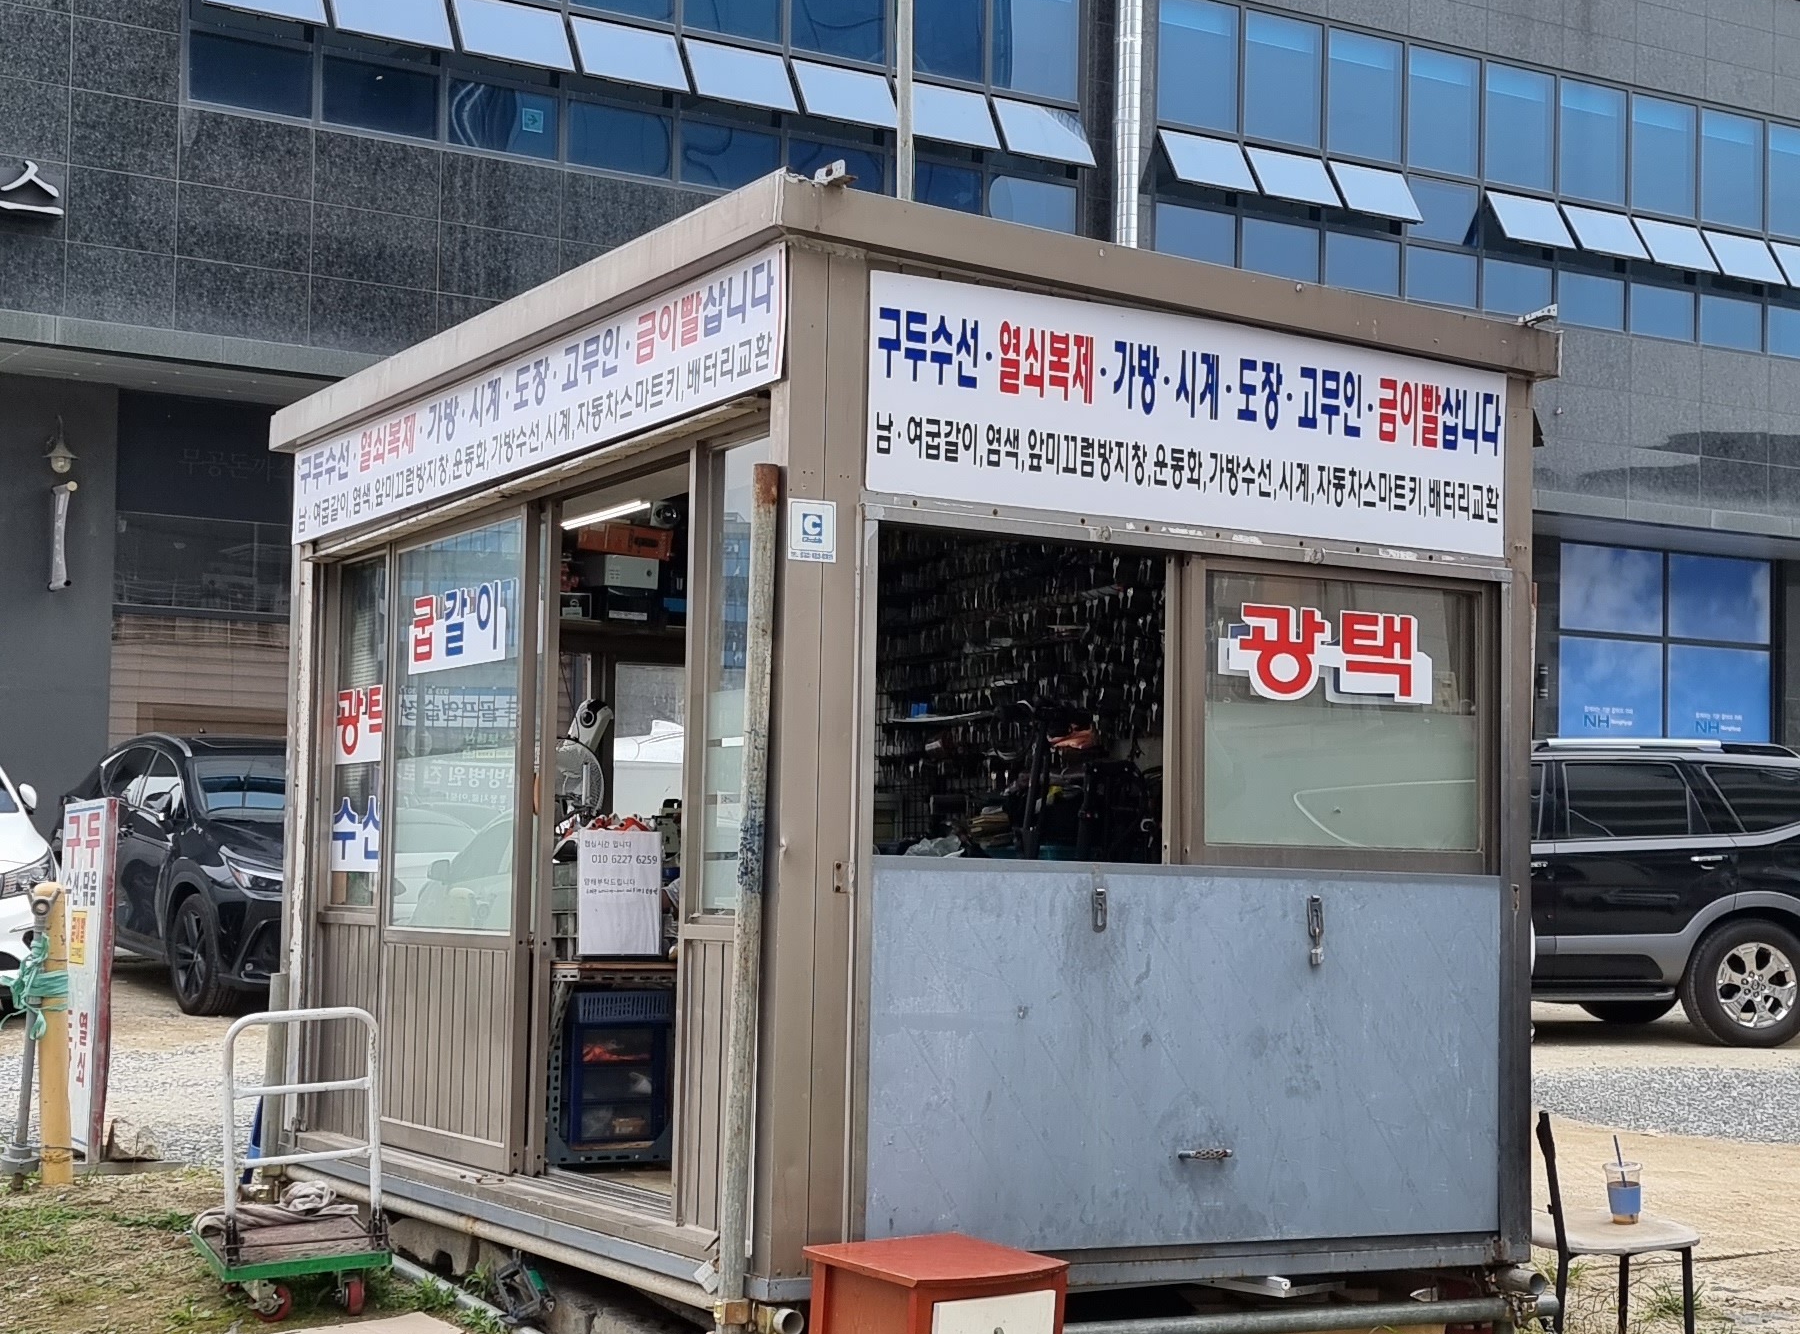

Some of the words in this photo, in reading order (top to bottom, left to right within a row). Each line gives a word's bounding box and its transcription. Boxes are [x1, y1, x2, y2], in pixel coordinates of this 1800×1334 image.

[300, 440, 350, 494] 구두수선
[360, 412, 416, 473] 열쇠복제
[427, 395, 459, 444] 가방
[469, 377, 501, 427] 시계
[514, 356, 550, 411] 도장
[561, 326, 620, 392] 고무인
[878, 307, 979, 389] 구두수선
[1000, 321, 1094, 404] 열쇠복제
[1113, 340, 1159, 415] 가방
[1176, 350, 1219, 420] 시계
[1237, 358, 1282, 430] 도장
[1298, 366, 1361, 438] 고무인
[413, 580, 498, 662] 굽갈이
[1239, 605, 1412, 698] 광택
[66, 812, 100, 869] 구두
[591, 854, 608, 864] 010
